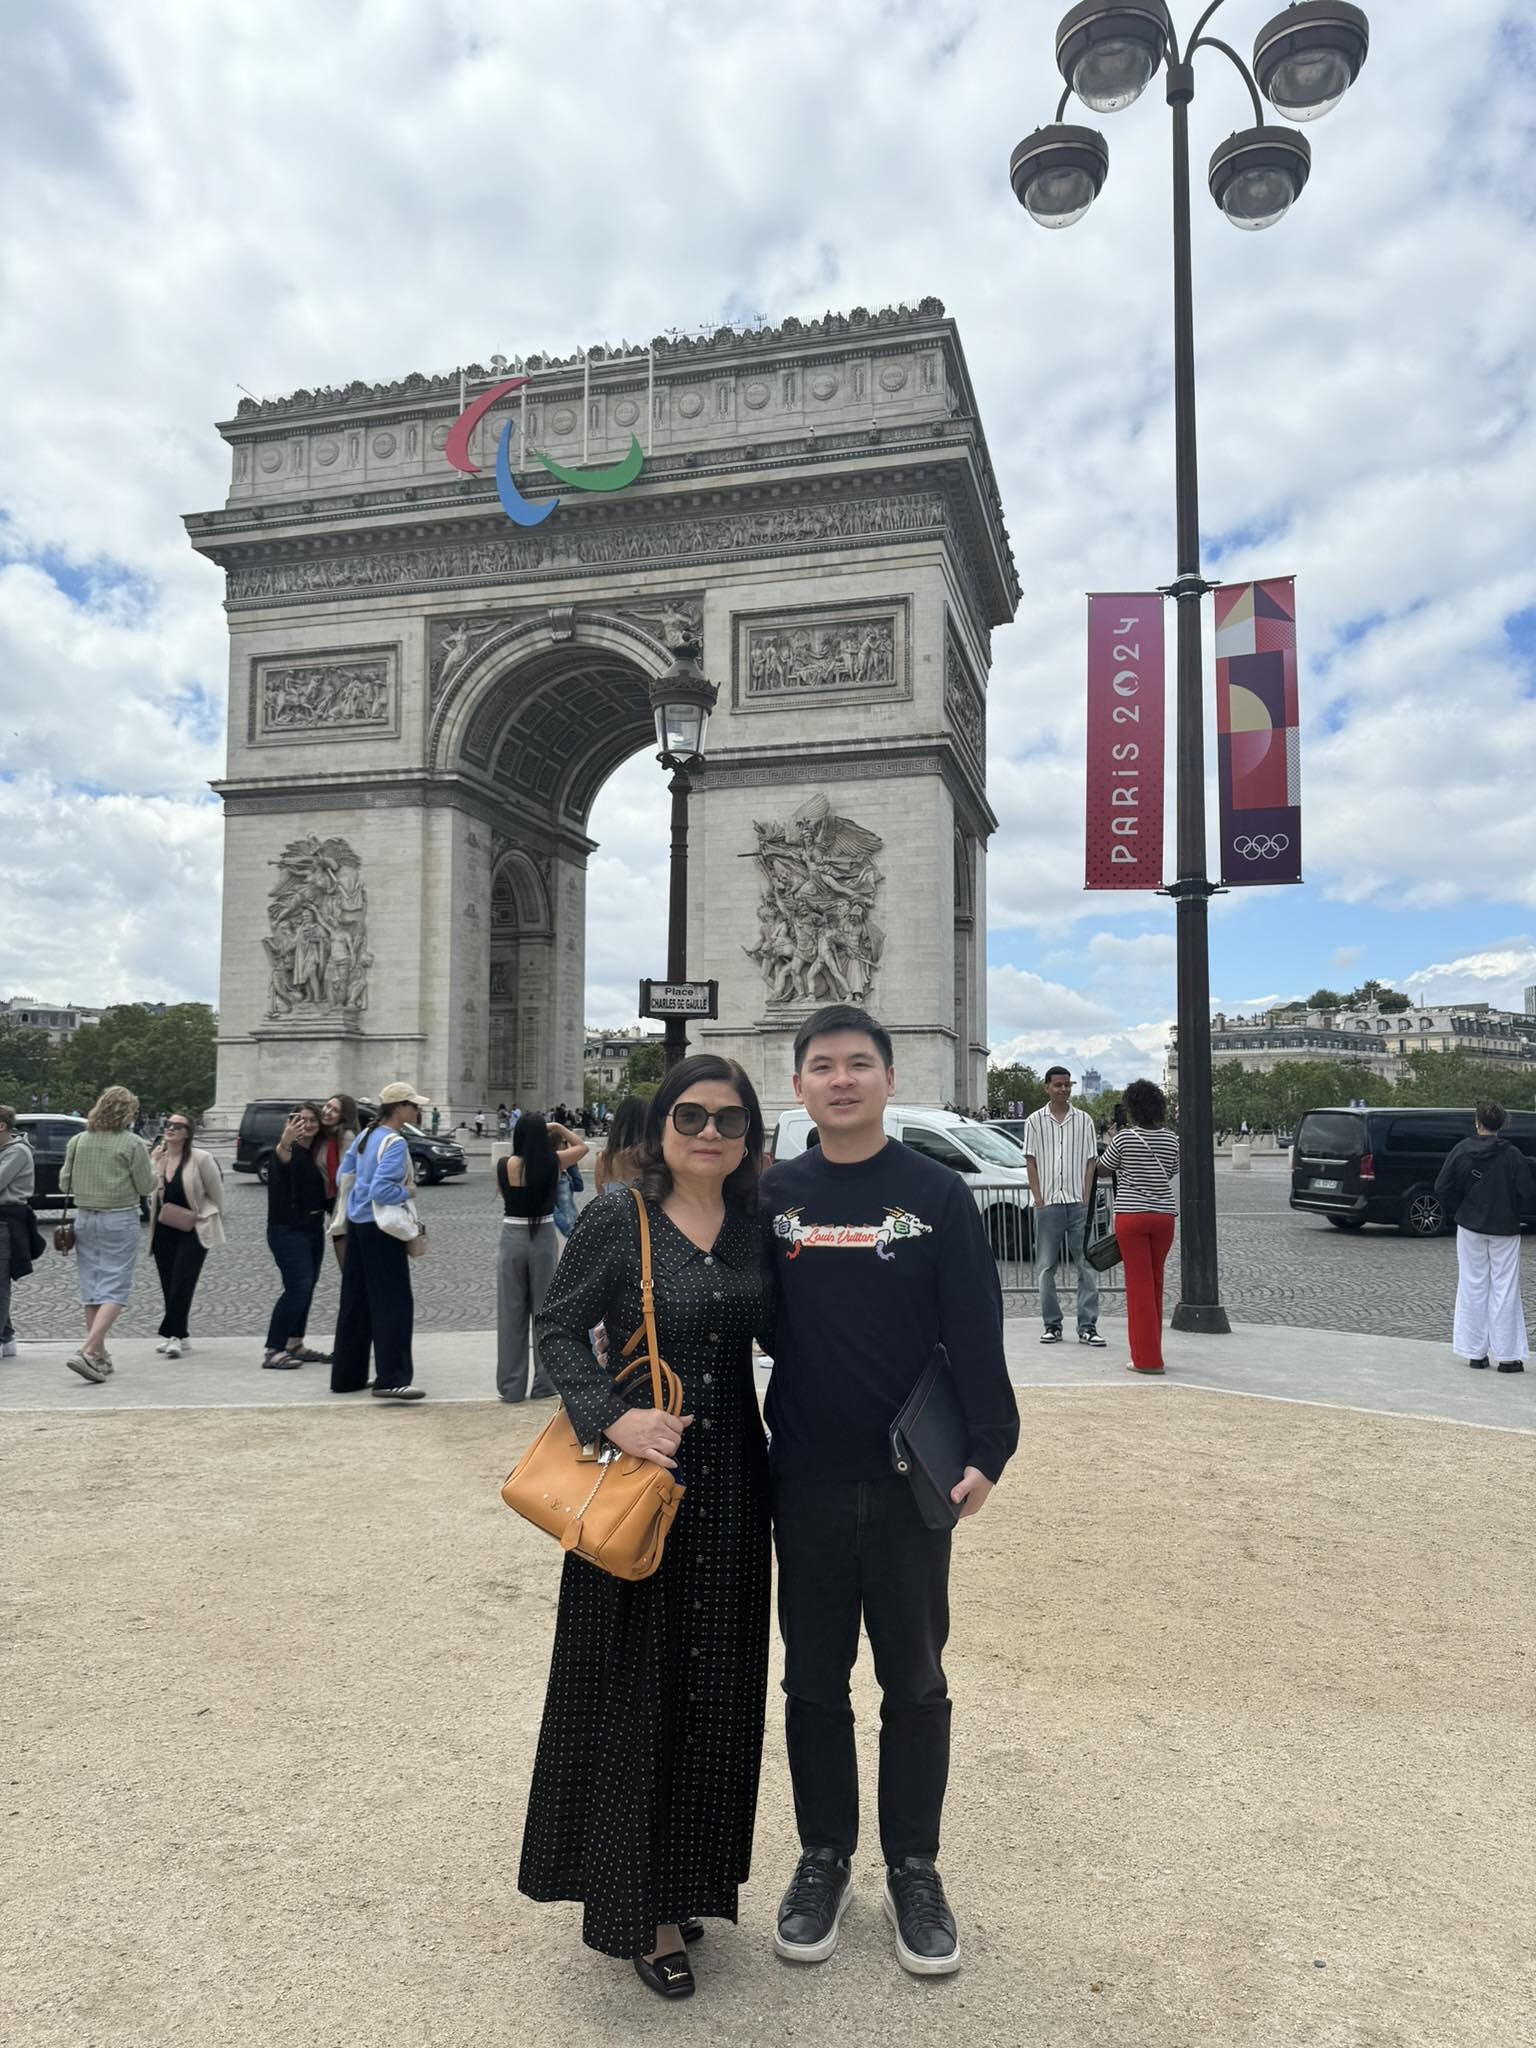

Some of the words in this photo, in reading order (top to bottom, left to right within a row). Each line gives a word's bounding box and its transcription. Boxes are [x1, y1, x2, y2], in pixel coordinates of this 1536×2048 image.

[1112, 617, 1140, 724] 2024
[664, 987, 694, 996] Place
[651, 998, 677, 1010] CHARLES
[685, 999, 707, 1010] GAULLE
[804, 1228, 835, 1244] Louis
[837, 1228, 875, 1244] Vuitton
